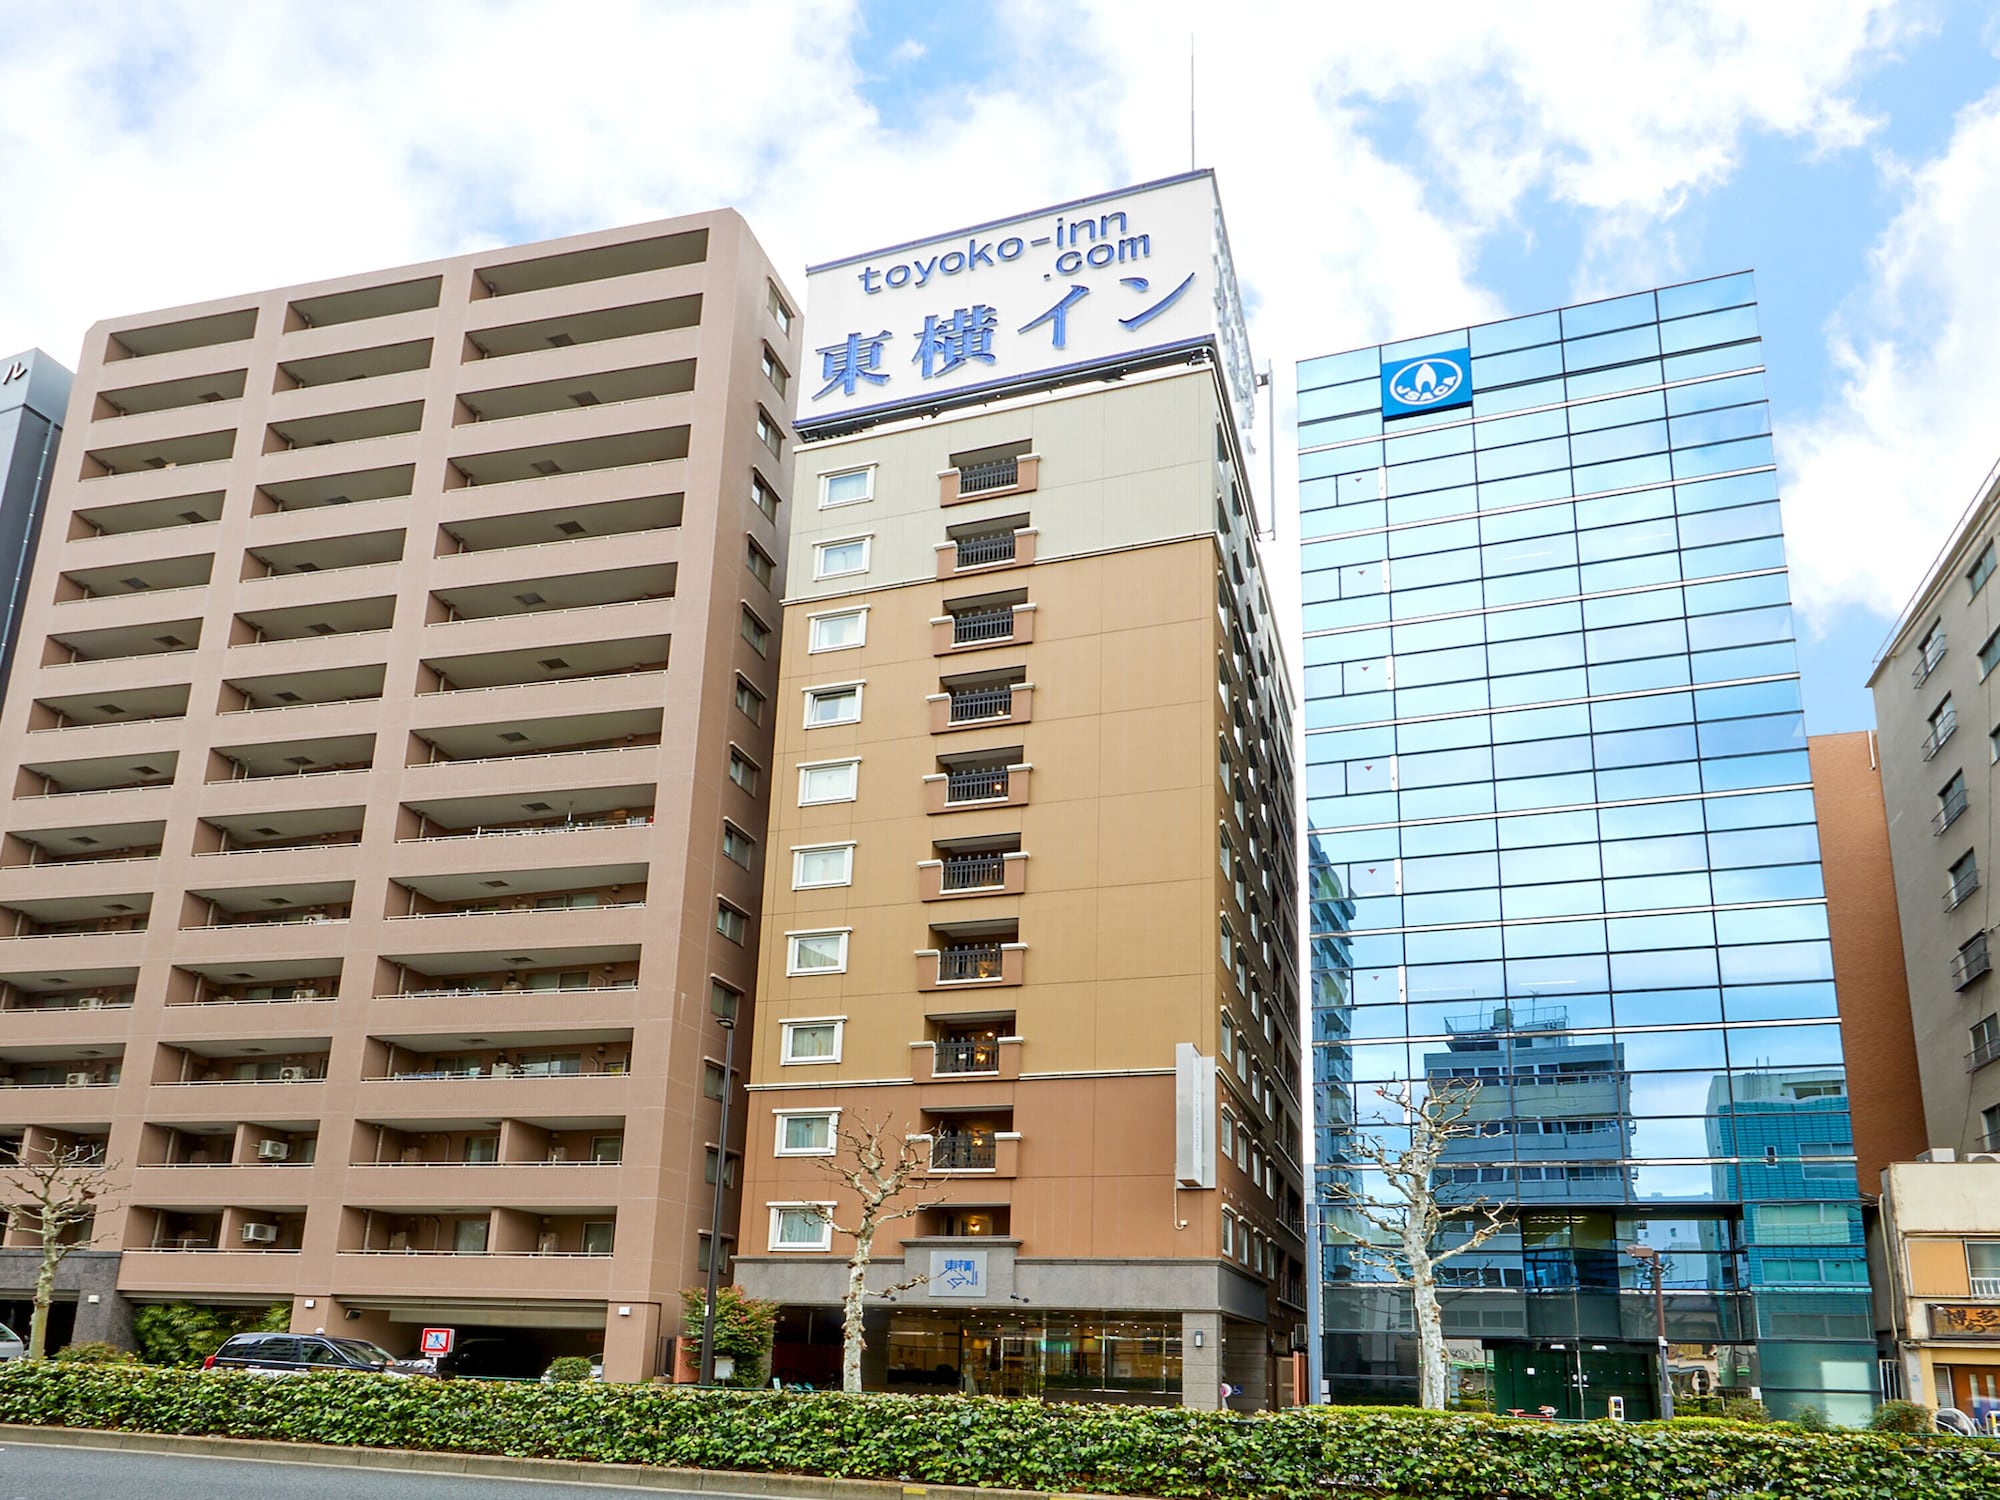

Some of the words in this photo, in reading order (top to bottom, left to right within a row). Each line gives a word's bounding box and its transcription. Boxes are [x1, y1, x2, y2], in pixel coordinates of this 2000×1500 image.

[858, 210, 1128, 295] toyoko-inn
[1043, 233, 1151, 281] .com
[812, 272, 1196, 400] 東横イン
